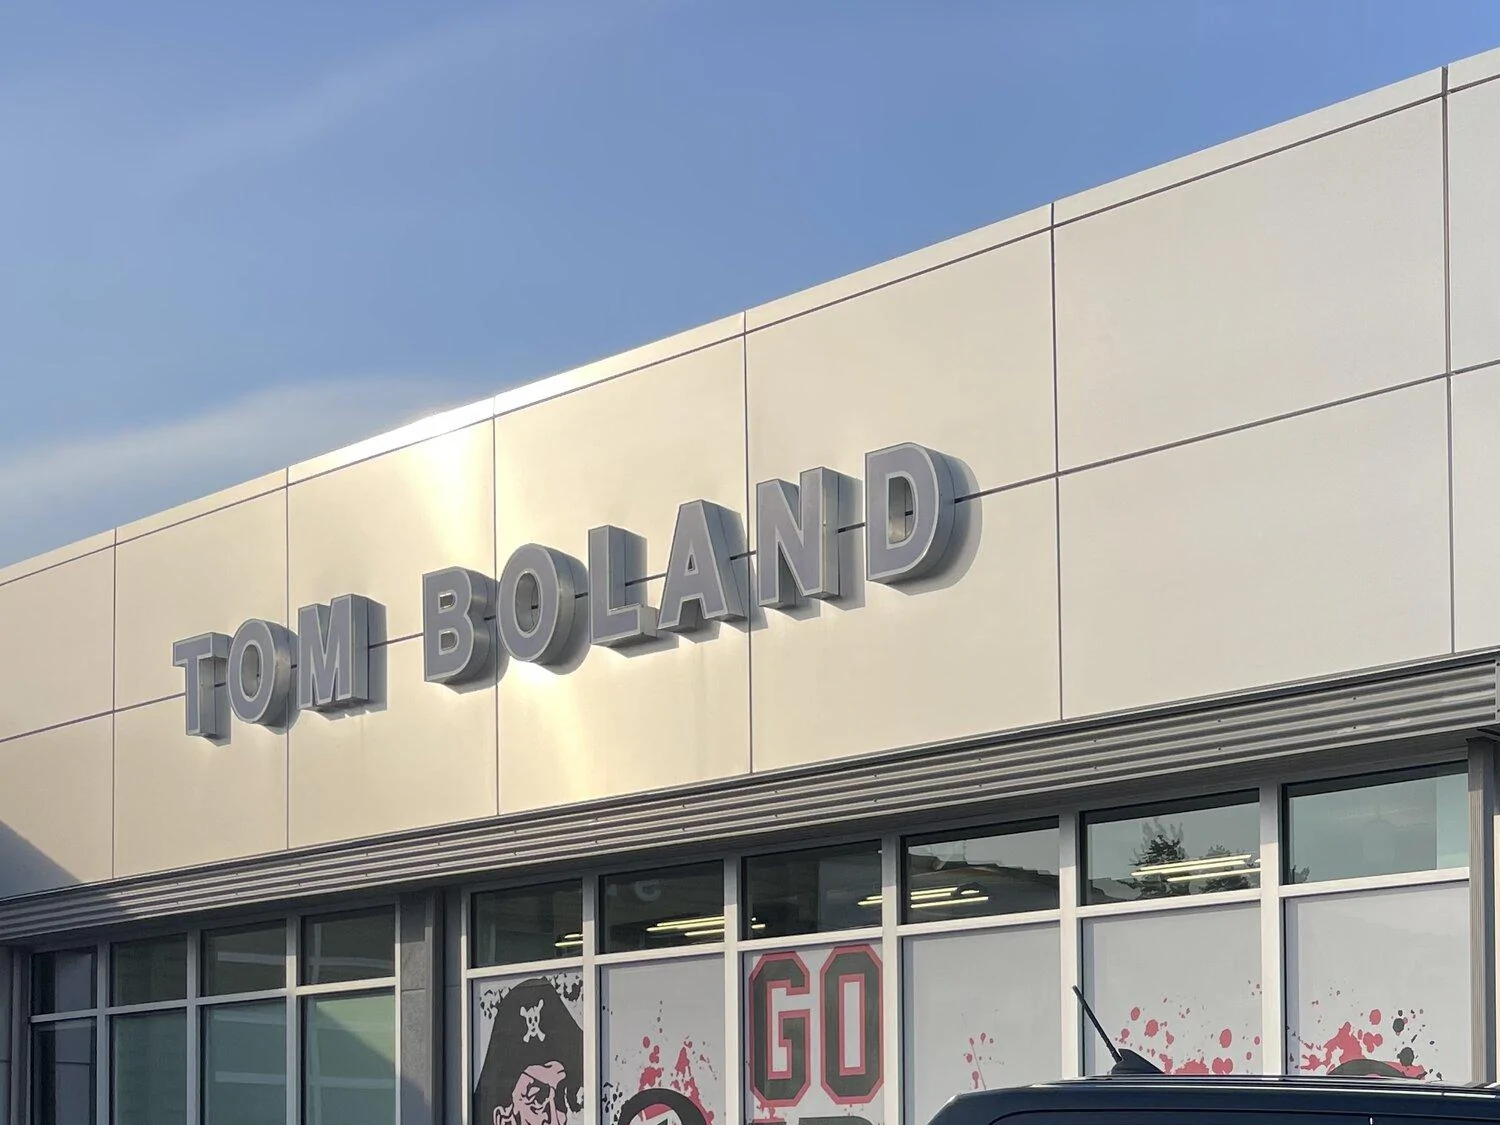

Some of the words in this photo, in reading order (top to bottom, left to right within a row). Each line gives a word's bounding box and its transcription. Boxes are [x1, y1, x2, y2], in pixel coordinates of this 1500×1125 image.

[173, 594, 369, 737] TOM
[423, 442, 958, 683] BOLAND
[749, 944, 884, 1107] GO
